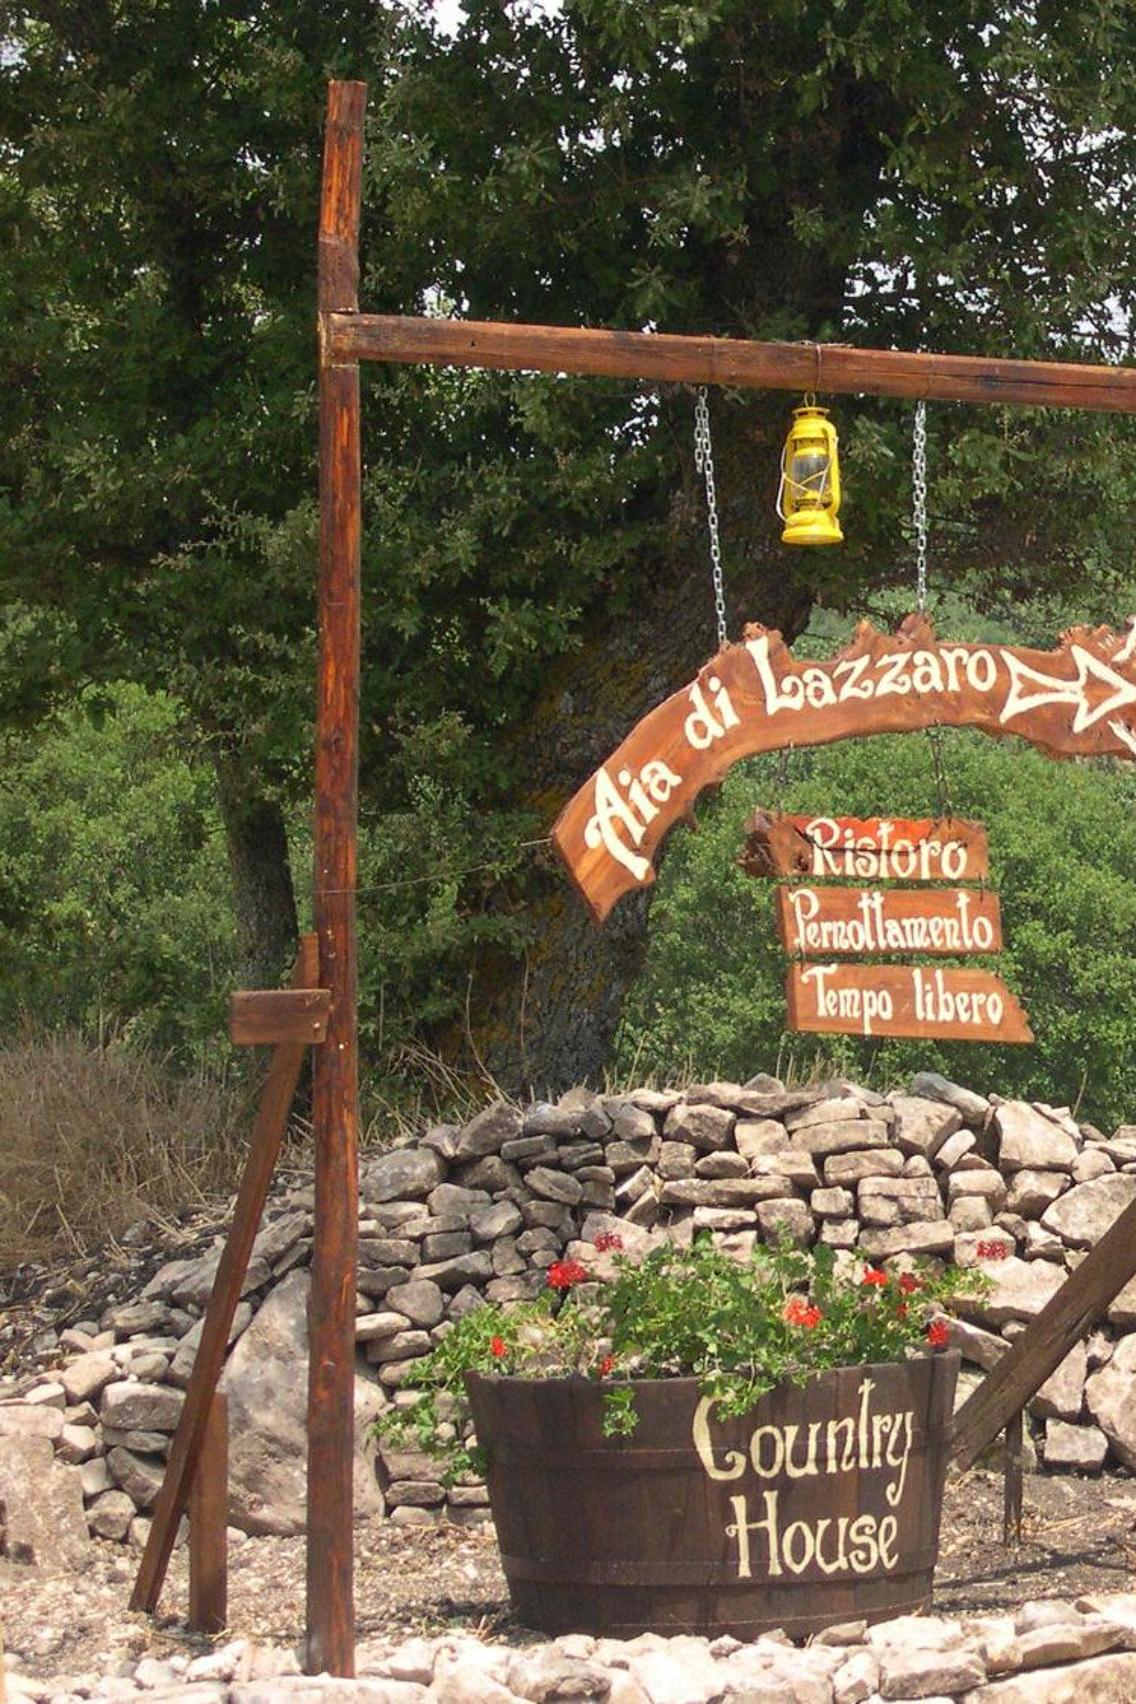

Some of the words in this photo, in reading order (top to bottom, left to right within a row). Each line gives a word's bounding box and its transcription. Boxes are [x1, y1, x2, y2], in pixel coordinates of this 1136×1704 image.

[585, 757, 682, 881] Aia
[684, 678, 740, 750] di
[746, 635, 996, 716] Lazzaro
[805, 817, 968, 879] Ristoro
[788, 889, 993, 950] Pernottamento
[801, 963, 893, 1034] Tempo
[912, 968, 1003, 1024] libero
[692, 1378, 914, 1506] Country
[725, 1490, 898, 1577] House
